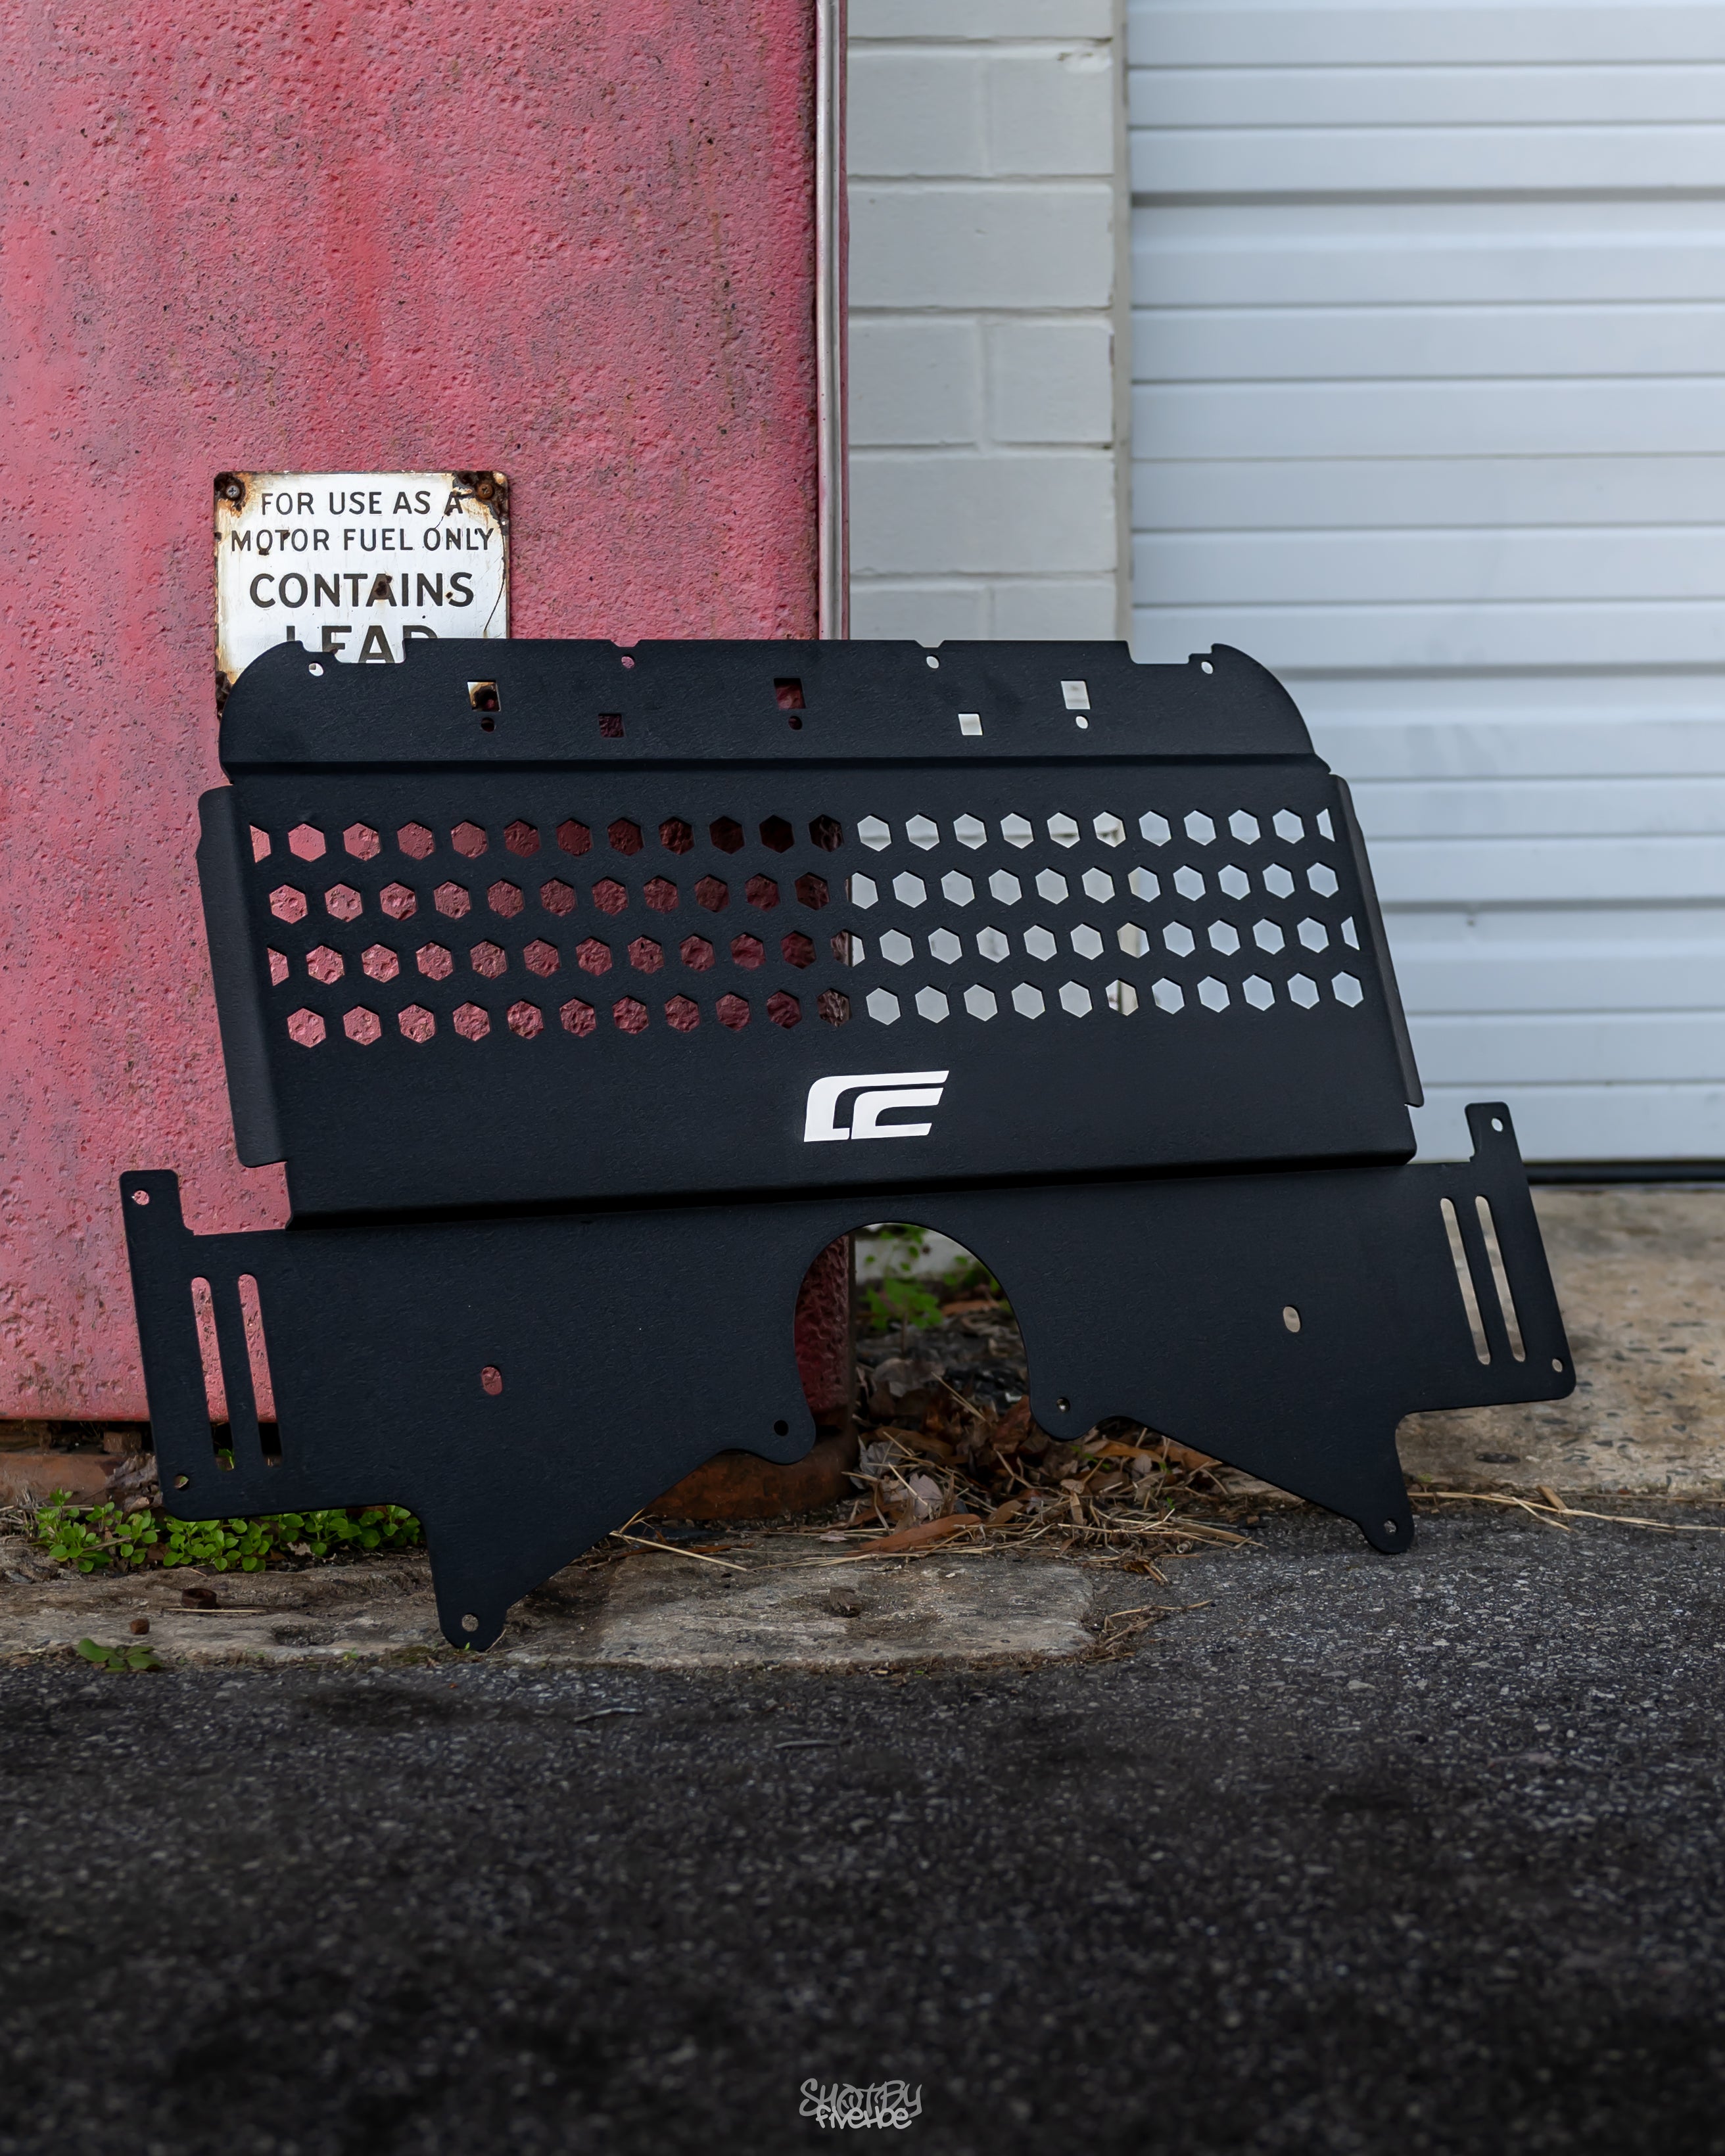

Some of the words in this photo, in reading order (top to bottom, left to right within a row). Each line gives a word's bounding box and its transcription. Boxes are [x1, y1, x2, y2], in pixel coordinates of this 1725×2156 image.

[261, 492, 315, 515] FOR
[329, 491, 382, 515] USE
[392, 491, 431, 515] AS
[444, 491, 463, 516] A
[231, 528, 329, 553] MOTOR
[344, 528, 414, 551] FUEL
[423, 527, 494, 551] ONLY
[249, 573, 475, 608] CONTAINS
